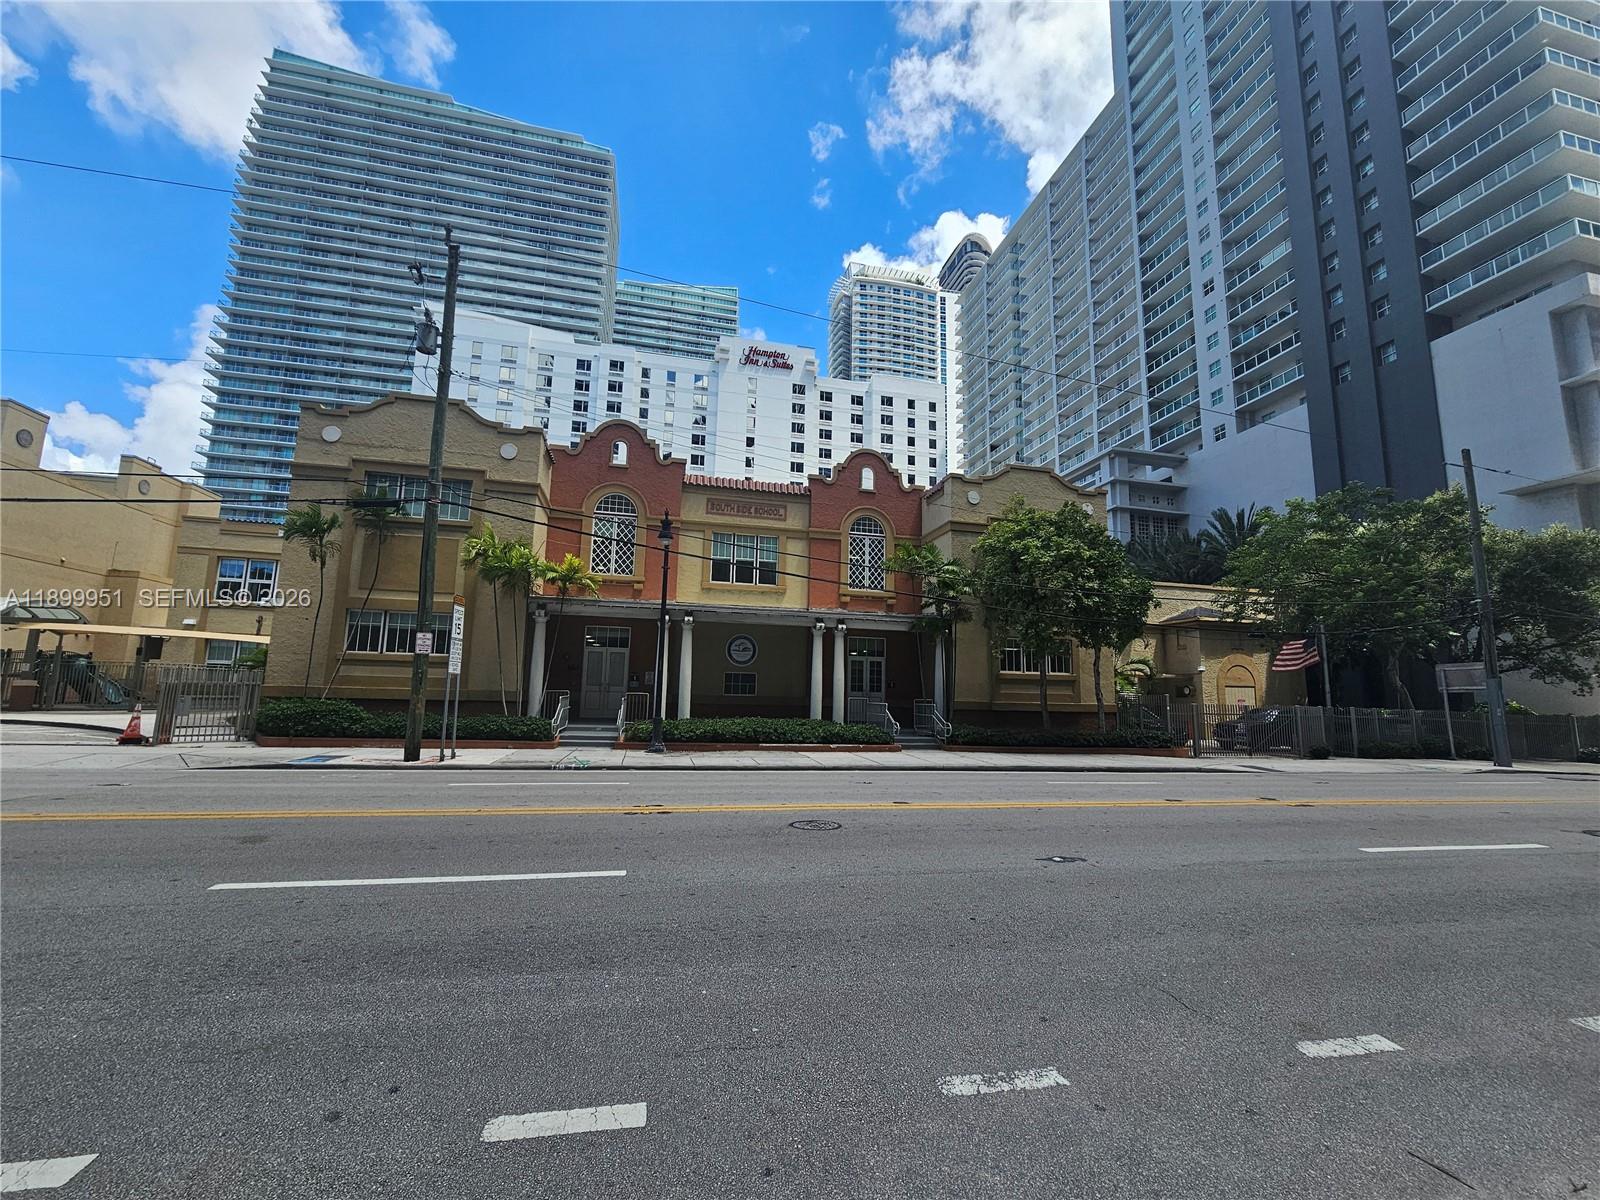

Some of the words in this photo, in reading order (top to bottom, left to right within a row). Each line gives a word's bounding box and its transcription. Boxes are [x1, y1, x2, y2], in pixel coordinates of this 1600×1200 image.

[743, 346, 790, 361] Hampton
[739, 356, 763, 367] Inn
[769, 359, 794, 370] Suites
[710, 502, 735, 513] SOUTH
[736, 504, 752, 515] SIDE
[754, 506, 783, 517] SCHOOL
[454, 623, 462, 635] 15
